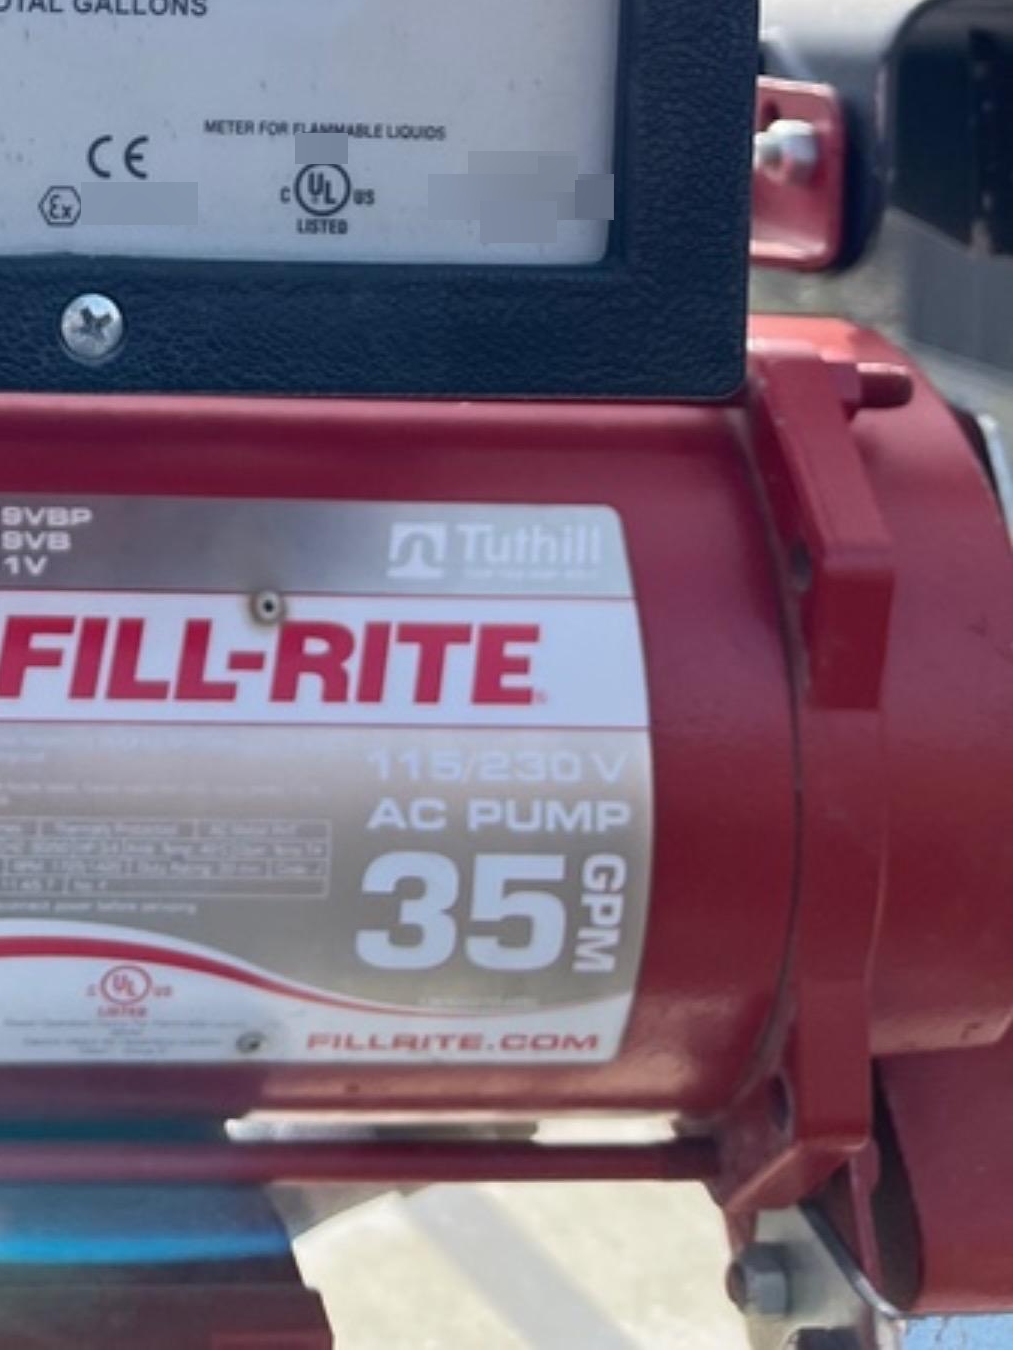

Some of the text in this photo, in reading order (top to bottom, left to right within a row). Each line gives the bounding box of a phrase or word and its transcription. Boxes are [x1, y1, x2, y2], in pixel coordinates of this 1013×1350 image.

[203, 119, 447, 141] METER FOR FLAMMABLE LIQUIDS
[87, 134, 150, 180] CE
[297, 218, 349, 235] LISTED
[455, 522, 603, 566] Tuthill
[367, 750, 582, 784] 115/230
[366, 797, 632, 833] AC PUMP
[354, 849, 628, 973] 35 GPM
[306, 1032, 601, 1052] FILLRITE.COM
